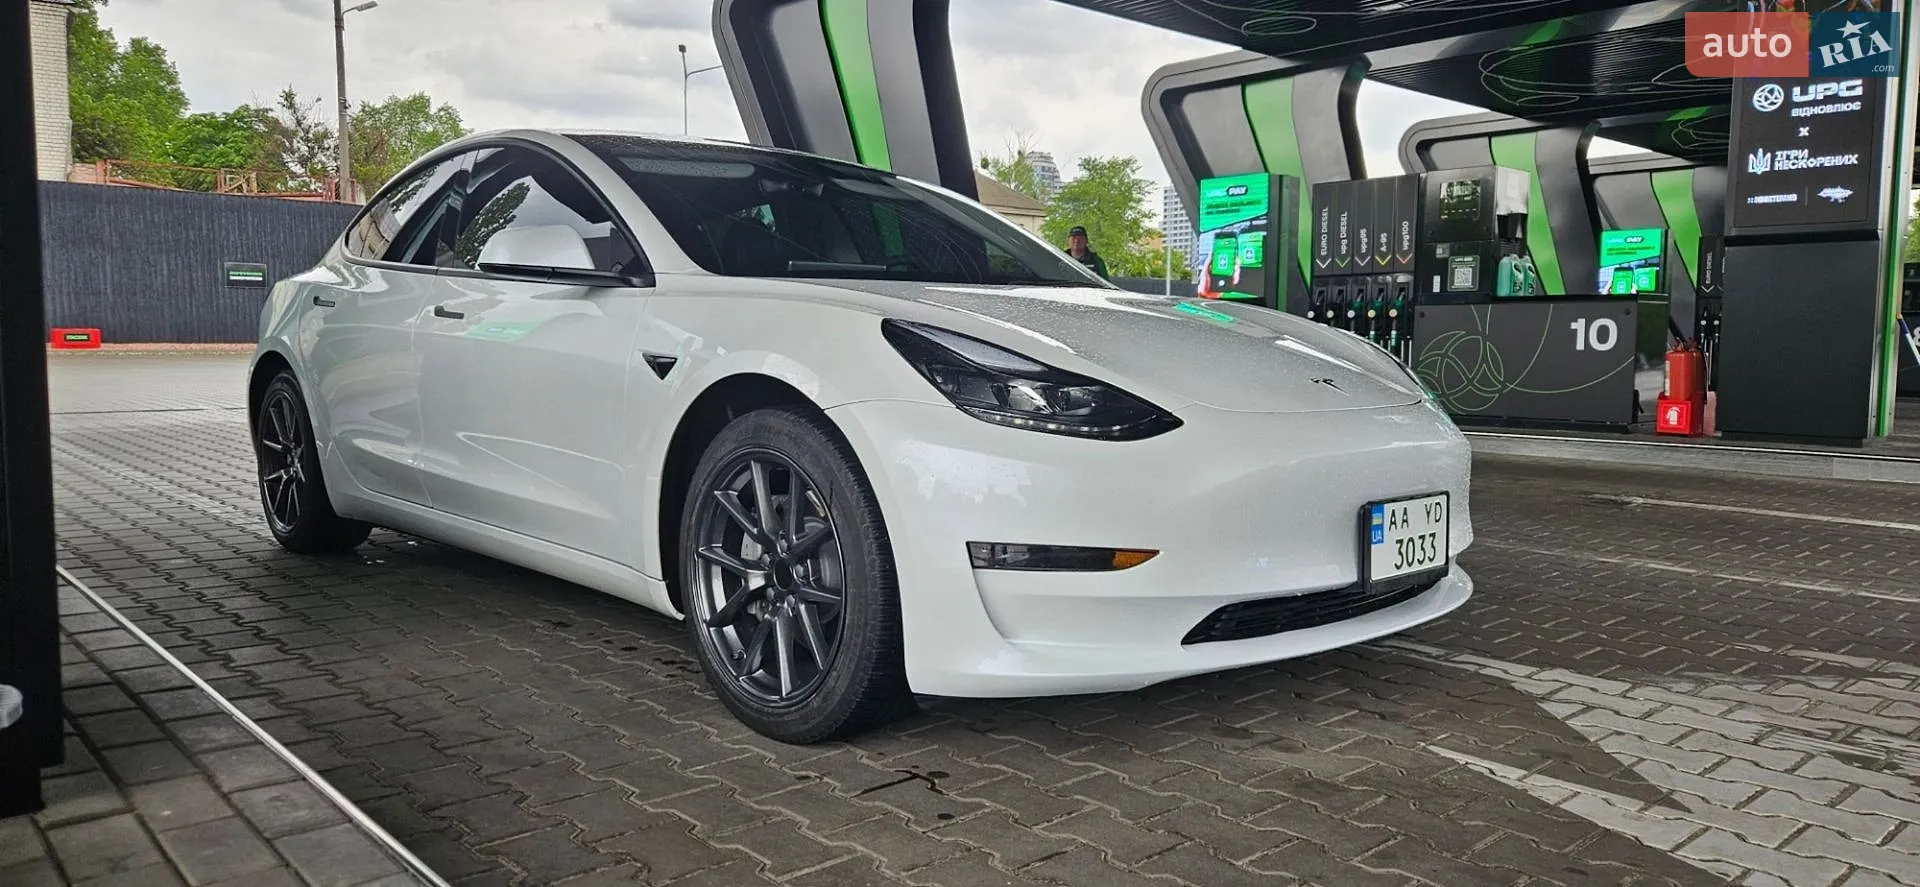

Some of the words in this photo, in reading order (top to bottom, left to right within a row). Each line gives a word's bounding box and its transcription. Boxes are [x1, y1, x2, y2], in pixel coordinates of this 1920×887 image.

[1792, 79, 1863, 102] UPG
[1791, 101, 1862, 117] ВІДНОВЛЮЄ
[1774, 154, 1859, 171] НЕСКОРЕНИХ
[1340, 211, 1348, 239] DIESEL
[1402, 221, 1410, 250] upg100
[1320, 234, 1328, 256] EURO
[1340, 239, 1348, 255] upg
[1570, 318, 1618, 351] 10
[1388, 507, 1409, 532] AA
[1425, 501, 1443, 524] YD
[1372, 529, 1384, 543] UA
[1394, 532, 1437, 570] 3033
